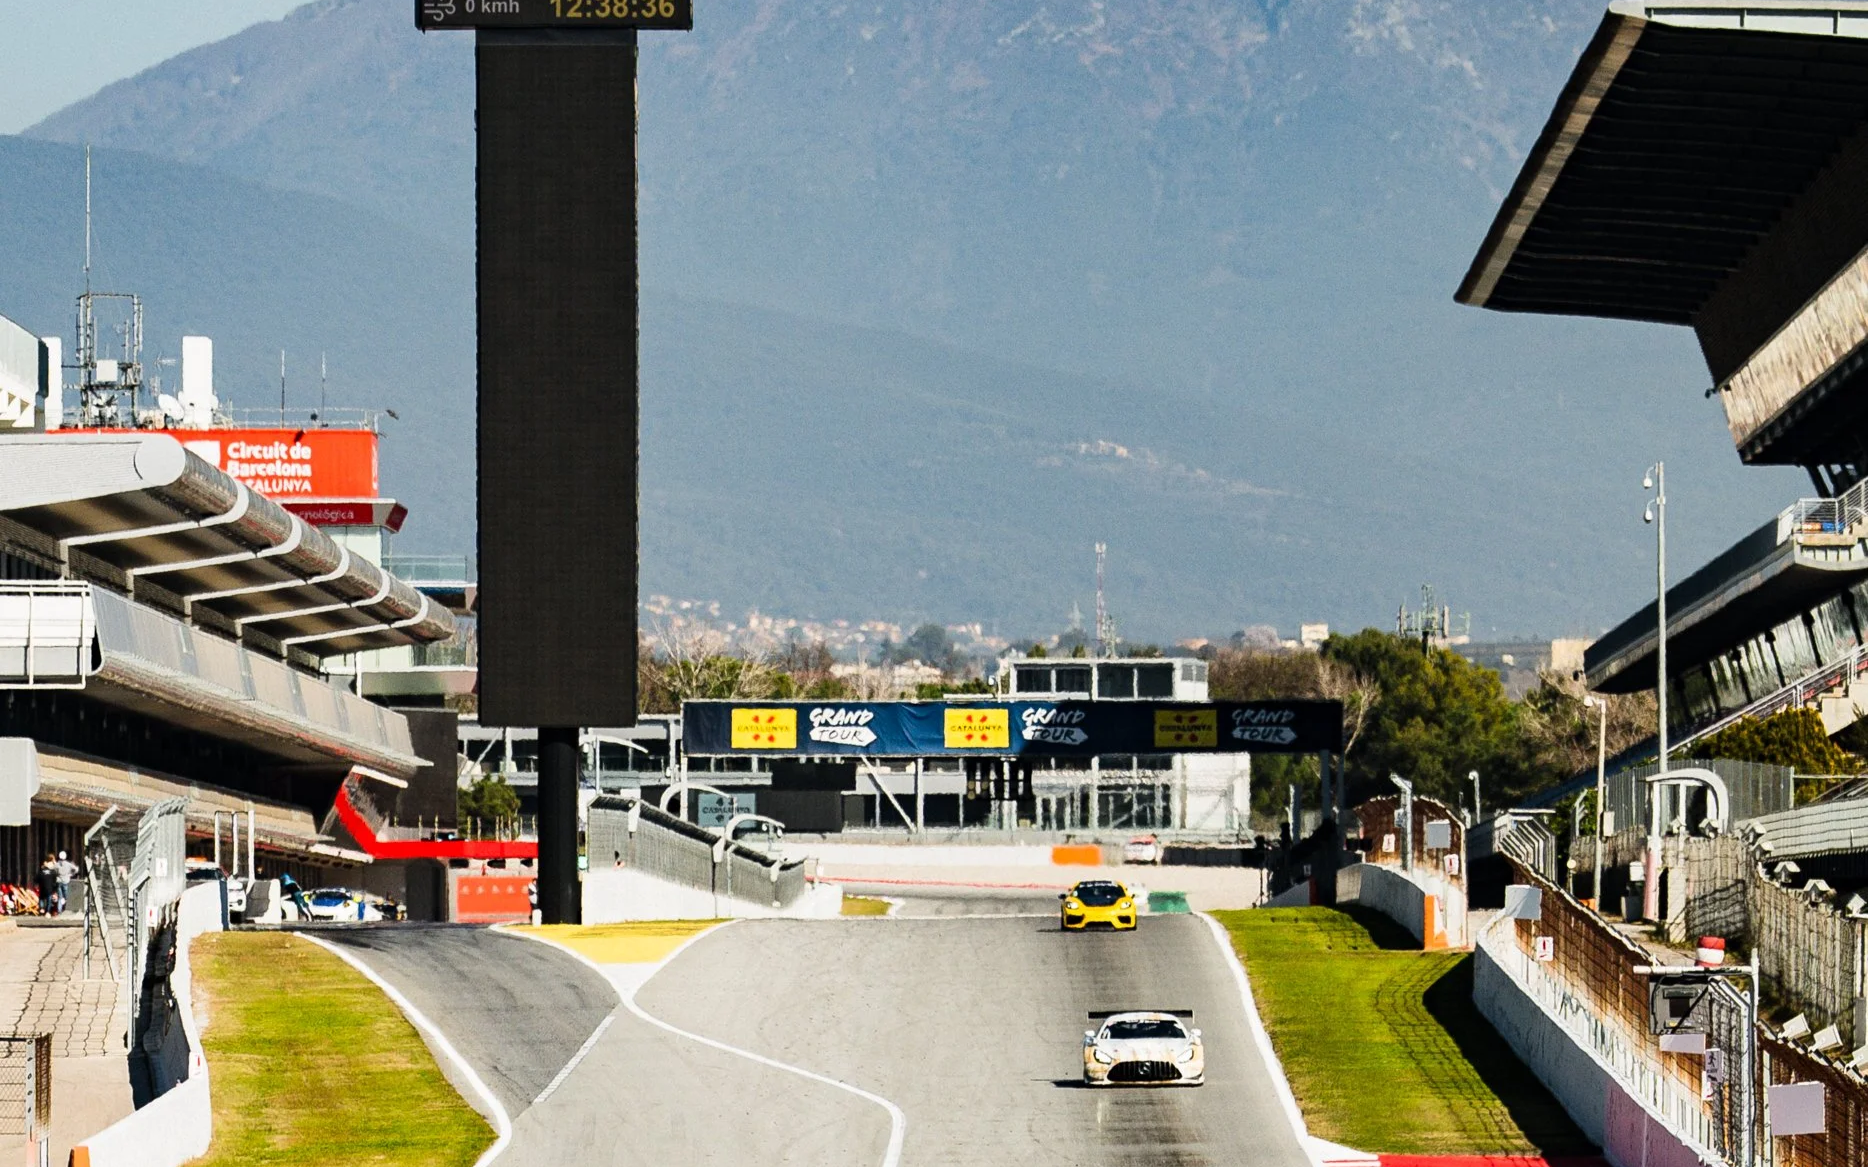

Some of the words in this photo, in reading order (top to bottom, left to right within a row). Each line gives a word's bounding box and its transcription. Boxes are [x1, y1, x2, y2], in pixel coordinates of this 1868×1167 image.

[465, 0, 475, 13] 0
[482, 0, 520, 13] kmh
[551, 0, 676, 18] 12:38:36
[227, 441, 288, 459] Circuit
[290, 441, 312, 459] de
[227, 460, 312, 477] Barcelona
[245, 479, 312, 493] TALUNYA
[809, 707, 874, 727] GRAND
[1021, 707, 1085, 725] GRAND
[1231, 708, 1295, 724] GRAND
[737, 725, 790, 733] CATALUNYA
[818, 729, 865, 742] TOUR
[1031, 728, 1077, 742] TOUR
[1239, 728, 1287, 742] TOUR
